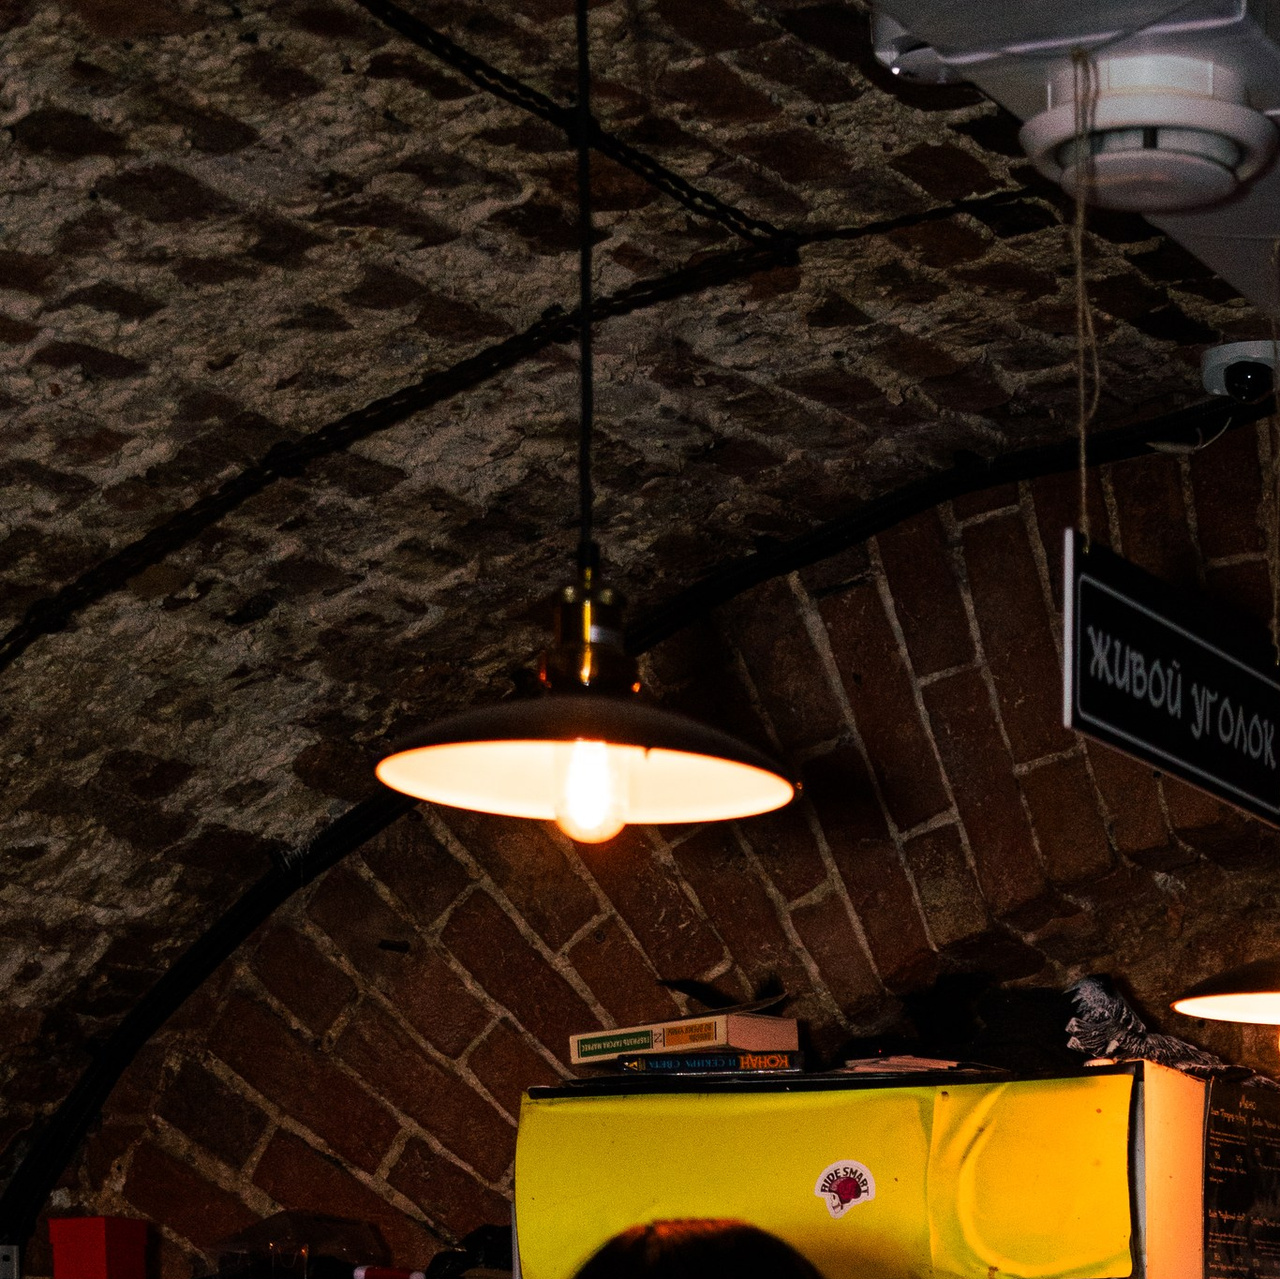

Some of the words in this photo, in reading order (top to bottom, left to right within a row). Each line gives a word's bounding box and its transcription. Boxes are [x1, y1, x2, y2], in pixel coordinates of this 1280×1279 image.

[739, 1054, 789, 1070] КОНАН
[820, 1168, 841, 1192] RIDE
[842, 1166, 869, 1196] SMART
